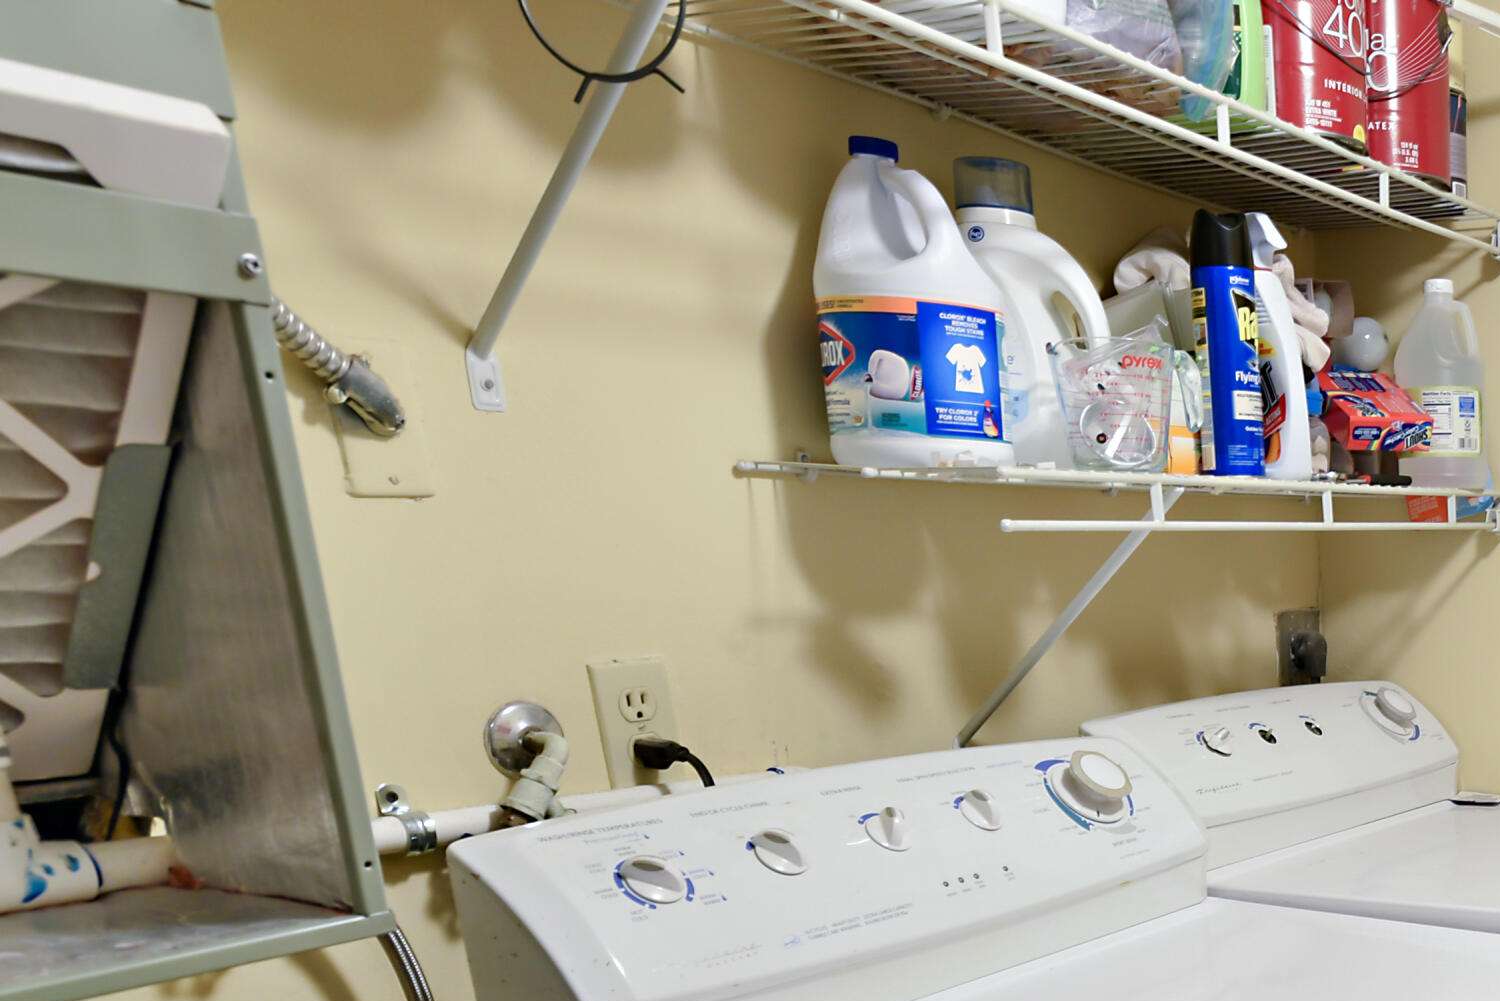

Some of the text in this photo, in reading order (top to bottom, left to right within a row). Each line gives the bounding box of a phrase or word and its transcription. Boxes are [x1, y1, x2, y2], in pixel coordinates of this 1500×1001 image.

[1367, 121, 1394, 130] ATEX
[1238, 306, 1258, 341] Ra
[1121, 354, 1162, 369] pyrex
